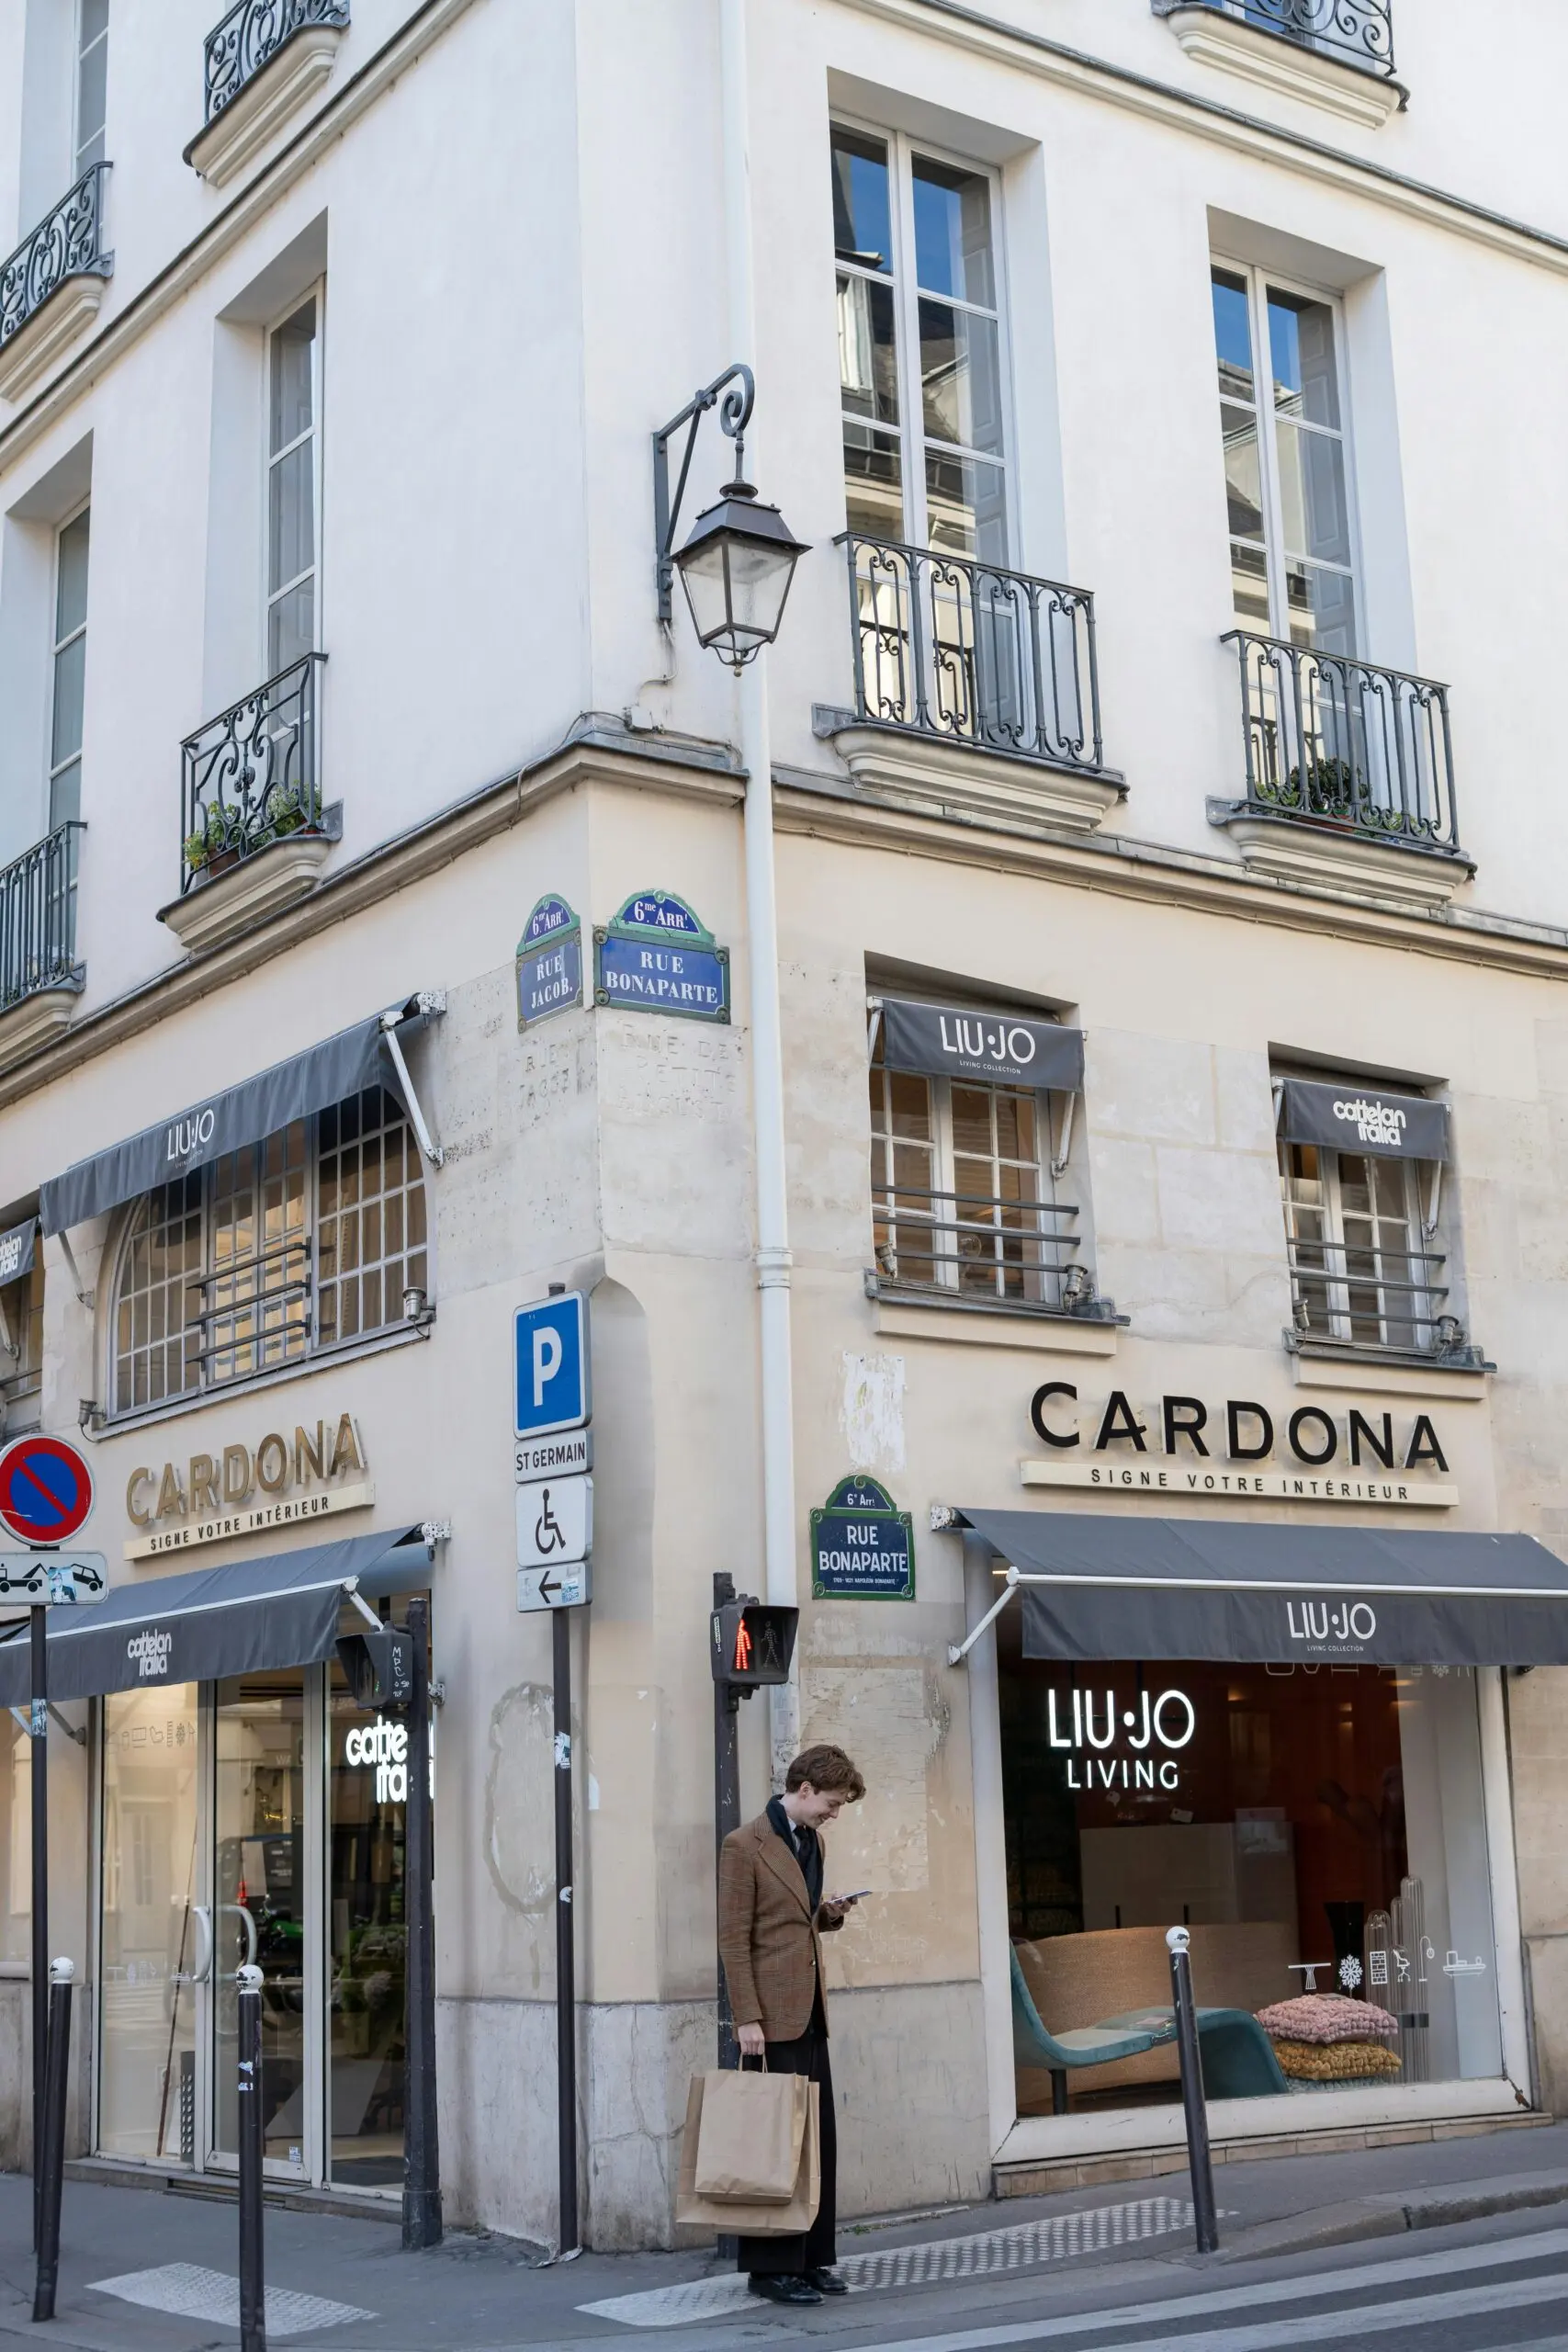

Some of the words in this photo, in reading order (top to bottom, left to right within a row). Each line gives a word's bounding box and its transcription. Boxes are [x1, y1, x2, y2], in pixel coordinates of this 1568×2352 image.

[536, 955, 562, 981] RUE
[640, 951, 683, 974] RUE
[606, 971, 718, 1003] BONAPARTE
[959, 1060, 981, 1069] LIVING
[983, 1063, 1021, 1075] COLLECTION
[1333, 1099, 1406, 1129] cattelan
[533, 1327, 562, 1408] P
[1029, 1380, 1450, 1472] CARDONA
[127, 1412, 366, 1526] CARDONA
[516, 1452, 530, 1472] ST
[533, 1442, 586, 1469] GERMAIN
[1091, 1468, 1168, 1487] SIGNE
[1187, 1473, 1264, 1492] VOTRE
[1282, 1478, 1409, 1500] INTÉRIEUR
[151, 1531, 189, 1551] SIGNE
[197, 1518, 240, 1540] VOTRE
[250, 1496, 330, 1528] INTÉRIEUR
[846, 1525, 879, 1545] RUE
[818, 1551, 908, 1572] BONAPARTE
[127, 1628, 172, 1658] cattelan
[1067, 1758, 1179, 1790] LIVING
